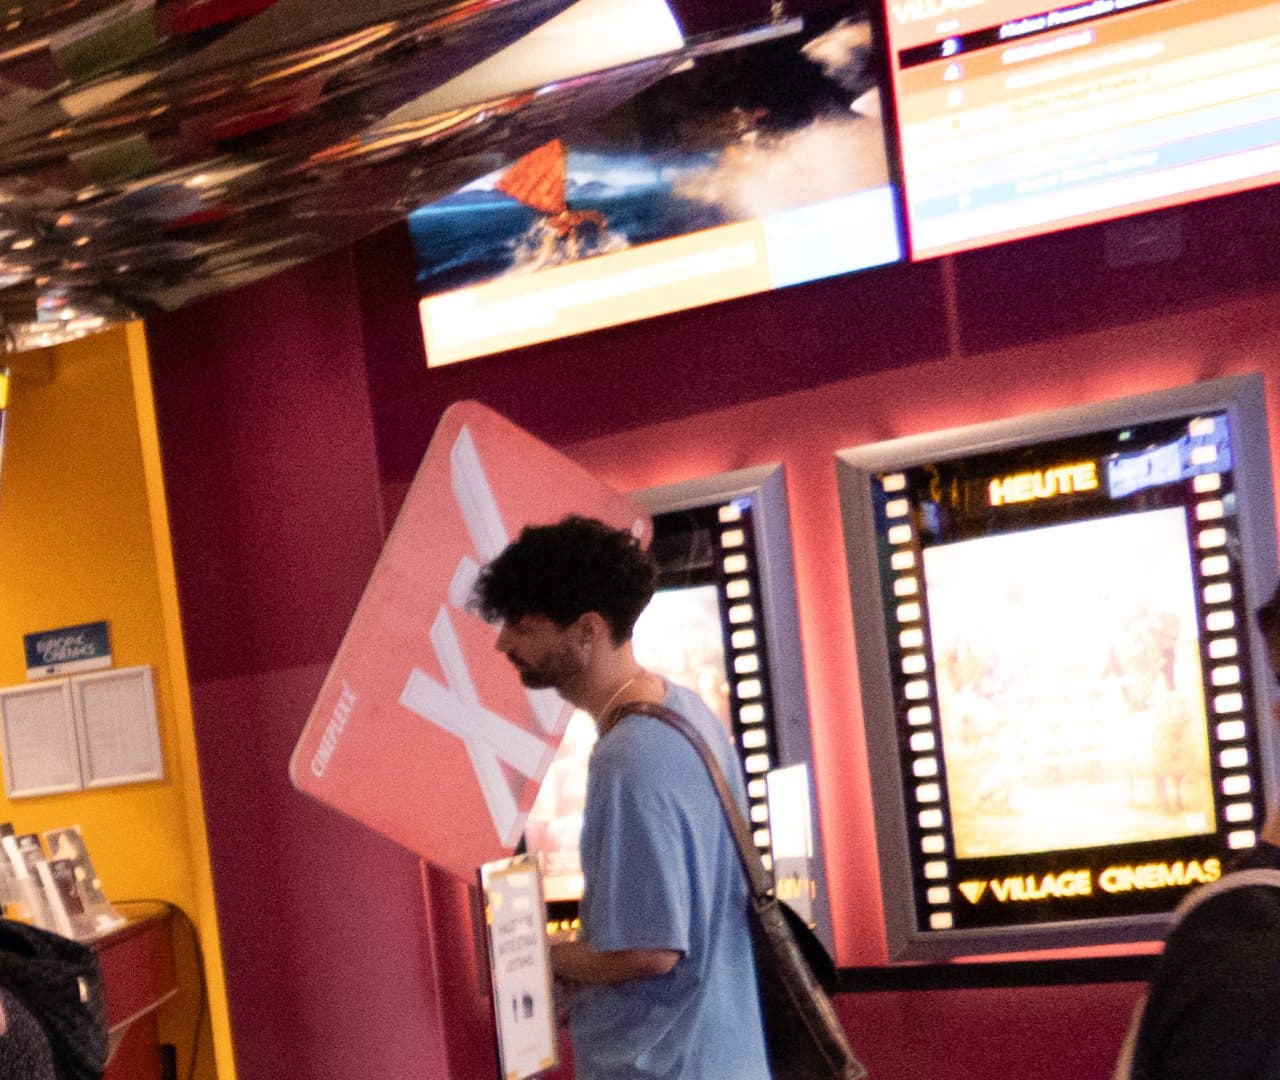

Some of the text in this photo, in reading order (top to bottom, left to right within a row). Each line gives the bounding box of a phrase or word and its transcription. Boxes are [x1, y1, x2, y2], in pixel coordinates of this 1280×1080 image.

[989, 461, 1097, 506] HEUTE
[311, 683, 357, 778] CINEPLEXX
[990, 859, 1222, 901] VILLAGE CINEMAS
